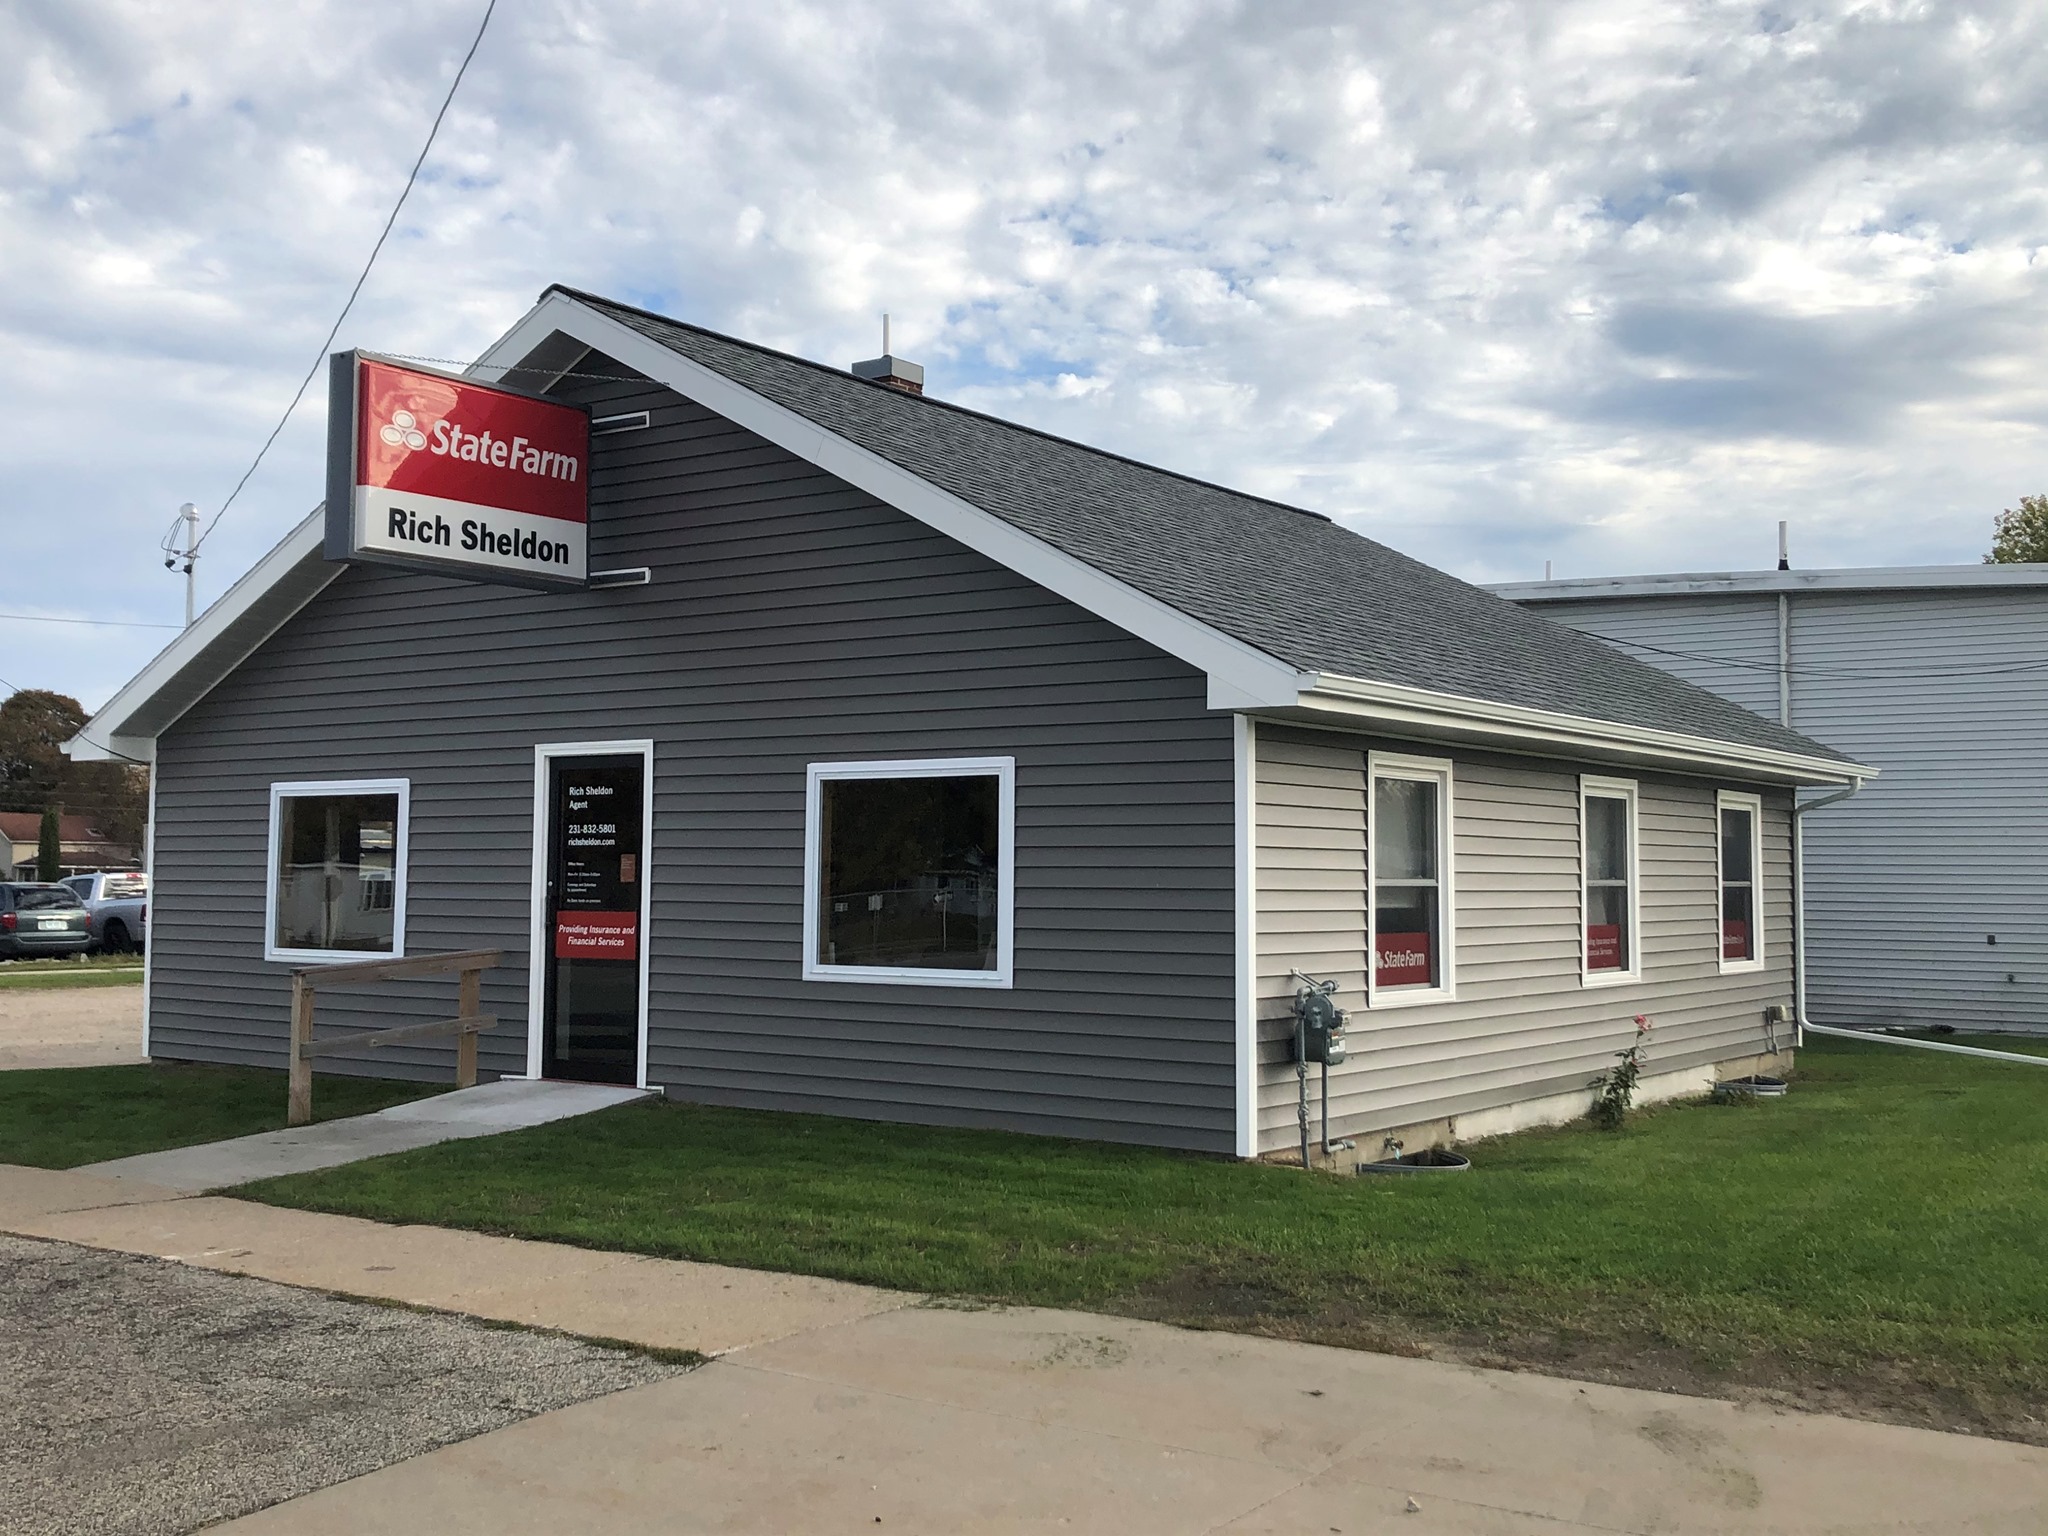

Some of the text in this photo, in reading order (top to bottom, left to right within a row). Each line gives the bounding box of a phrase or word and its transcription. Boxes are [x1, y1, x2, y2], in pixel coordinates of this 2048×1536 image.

[388, 507, 569, 565] Rich Sheldon
[569, 786, 613, 796] Rich Sheldon
[569, 800, 588, 811] Agent
[568, 824, 616, 834] 231-832-5801
[568, 838, 615, 846] richsheldon.com
[558, 924, 635, 935] Providing Insurance and
[567, 936, 625, 946] Financial Services
